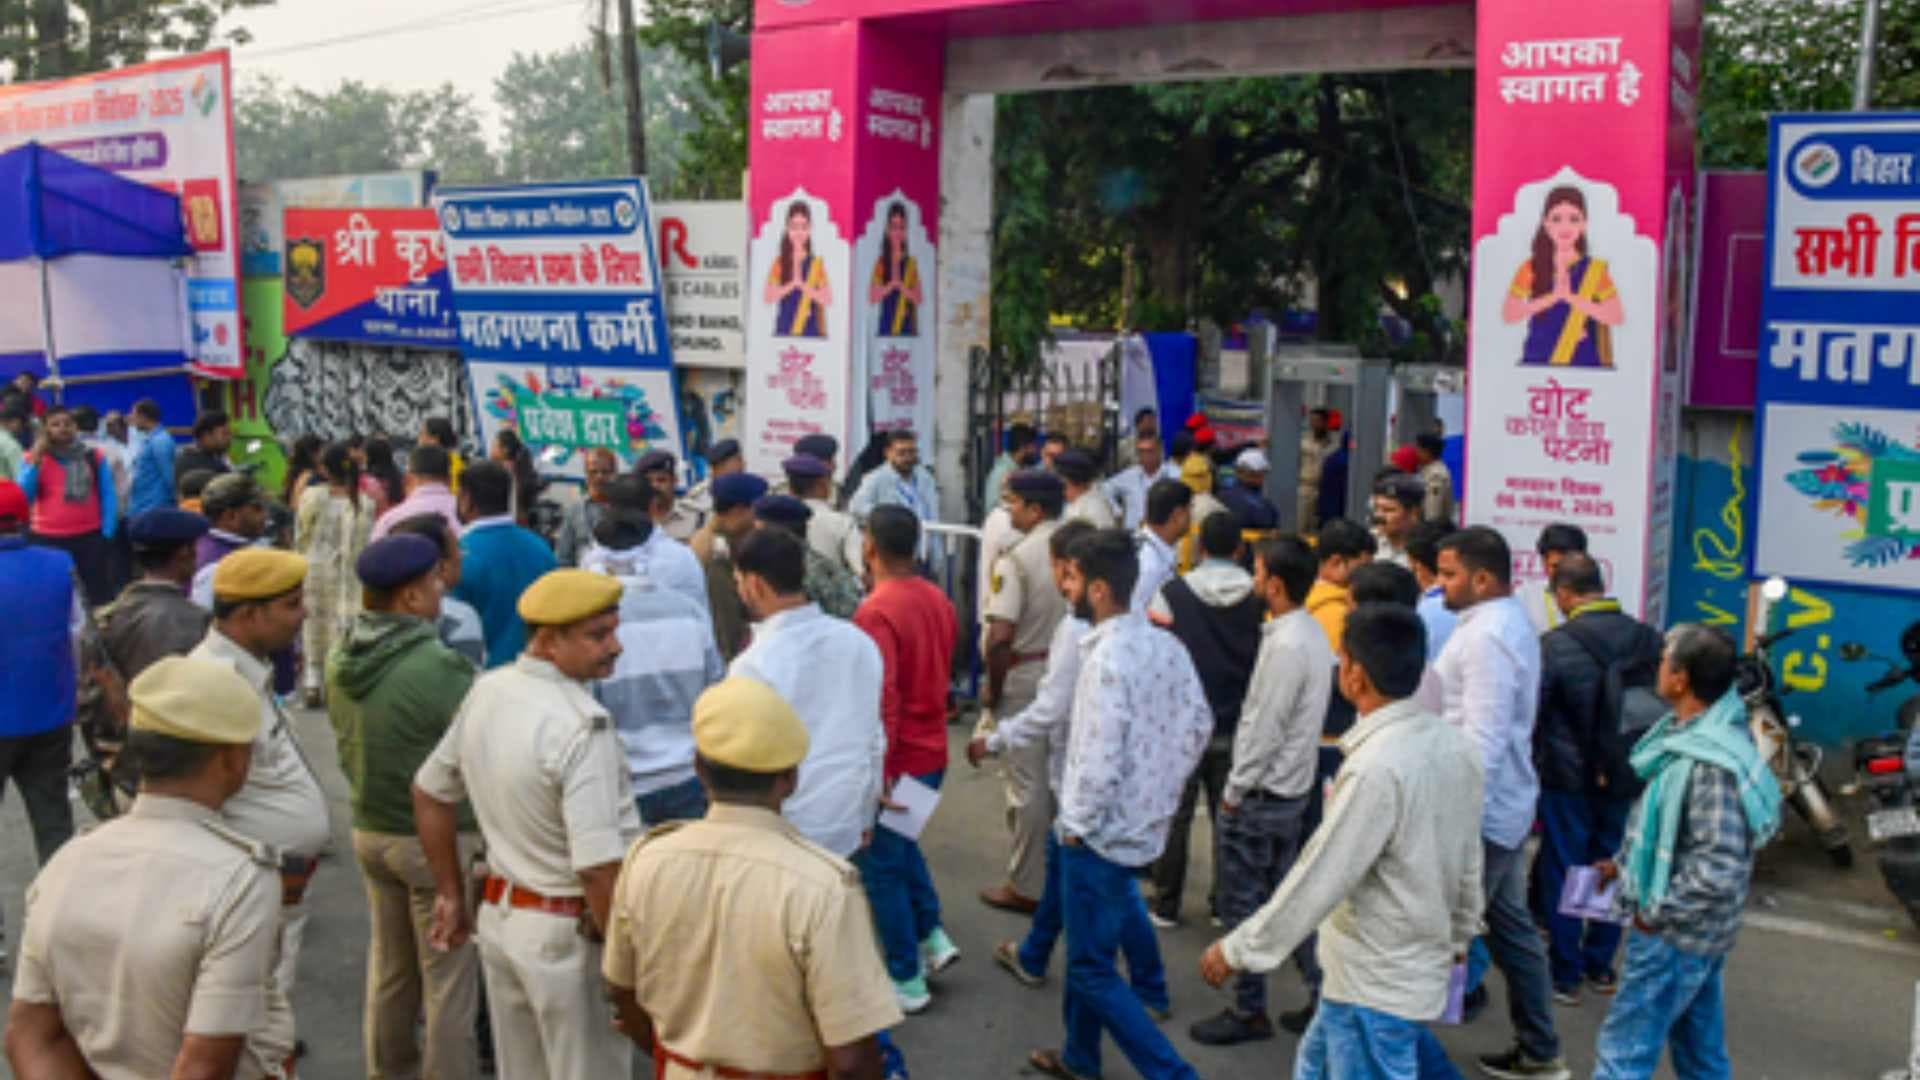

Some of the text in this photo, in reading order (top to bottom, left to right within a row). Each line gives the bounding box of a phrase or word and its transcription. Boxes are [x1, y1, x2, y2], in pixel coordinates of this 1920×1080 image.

[1500, 36, 1622, 69] आपका
[763, 88, 832, 112] आपका
[1498, 73, 1608, 104] स्वागत
[1617, 60, 1643, 106] है
[1851, 144, 1913, 185] बिहार
[335, 212, 379, 267] श्री
[1794, 213, 1882, 278] सभी
[456, 299, 659, 354] मतगणना कर्मी
[1526, 376, 1592, 420] वोट
